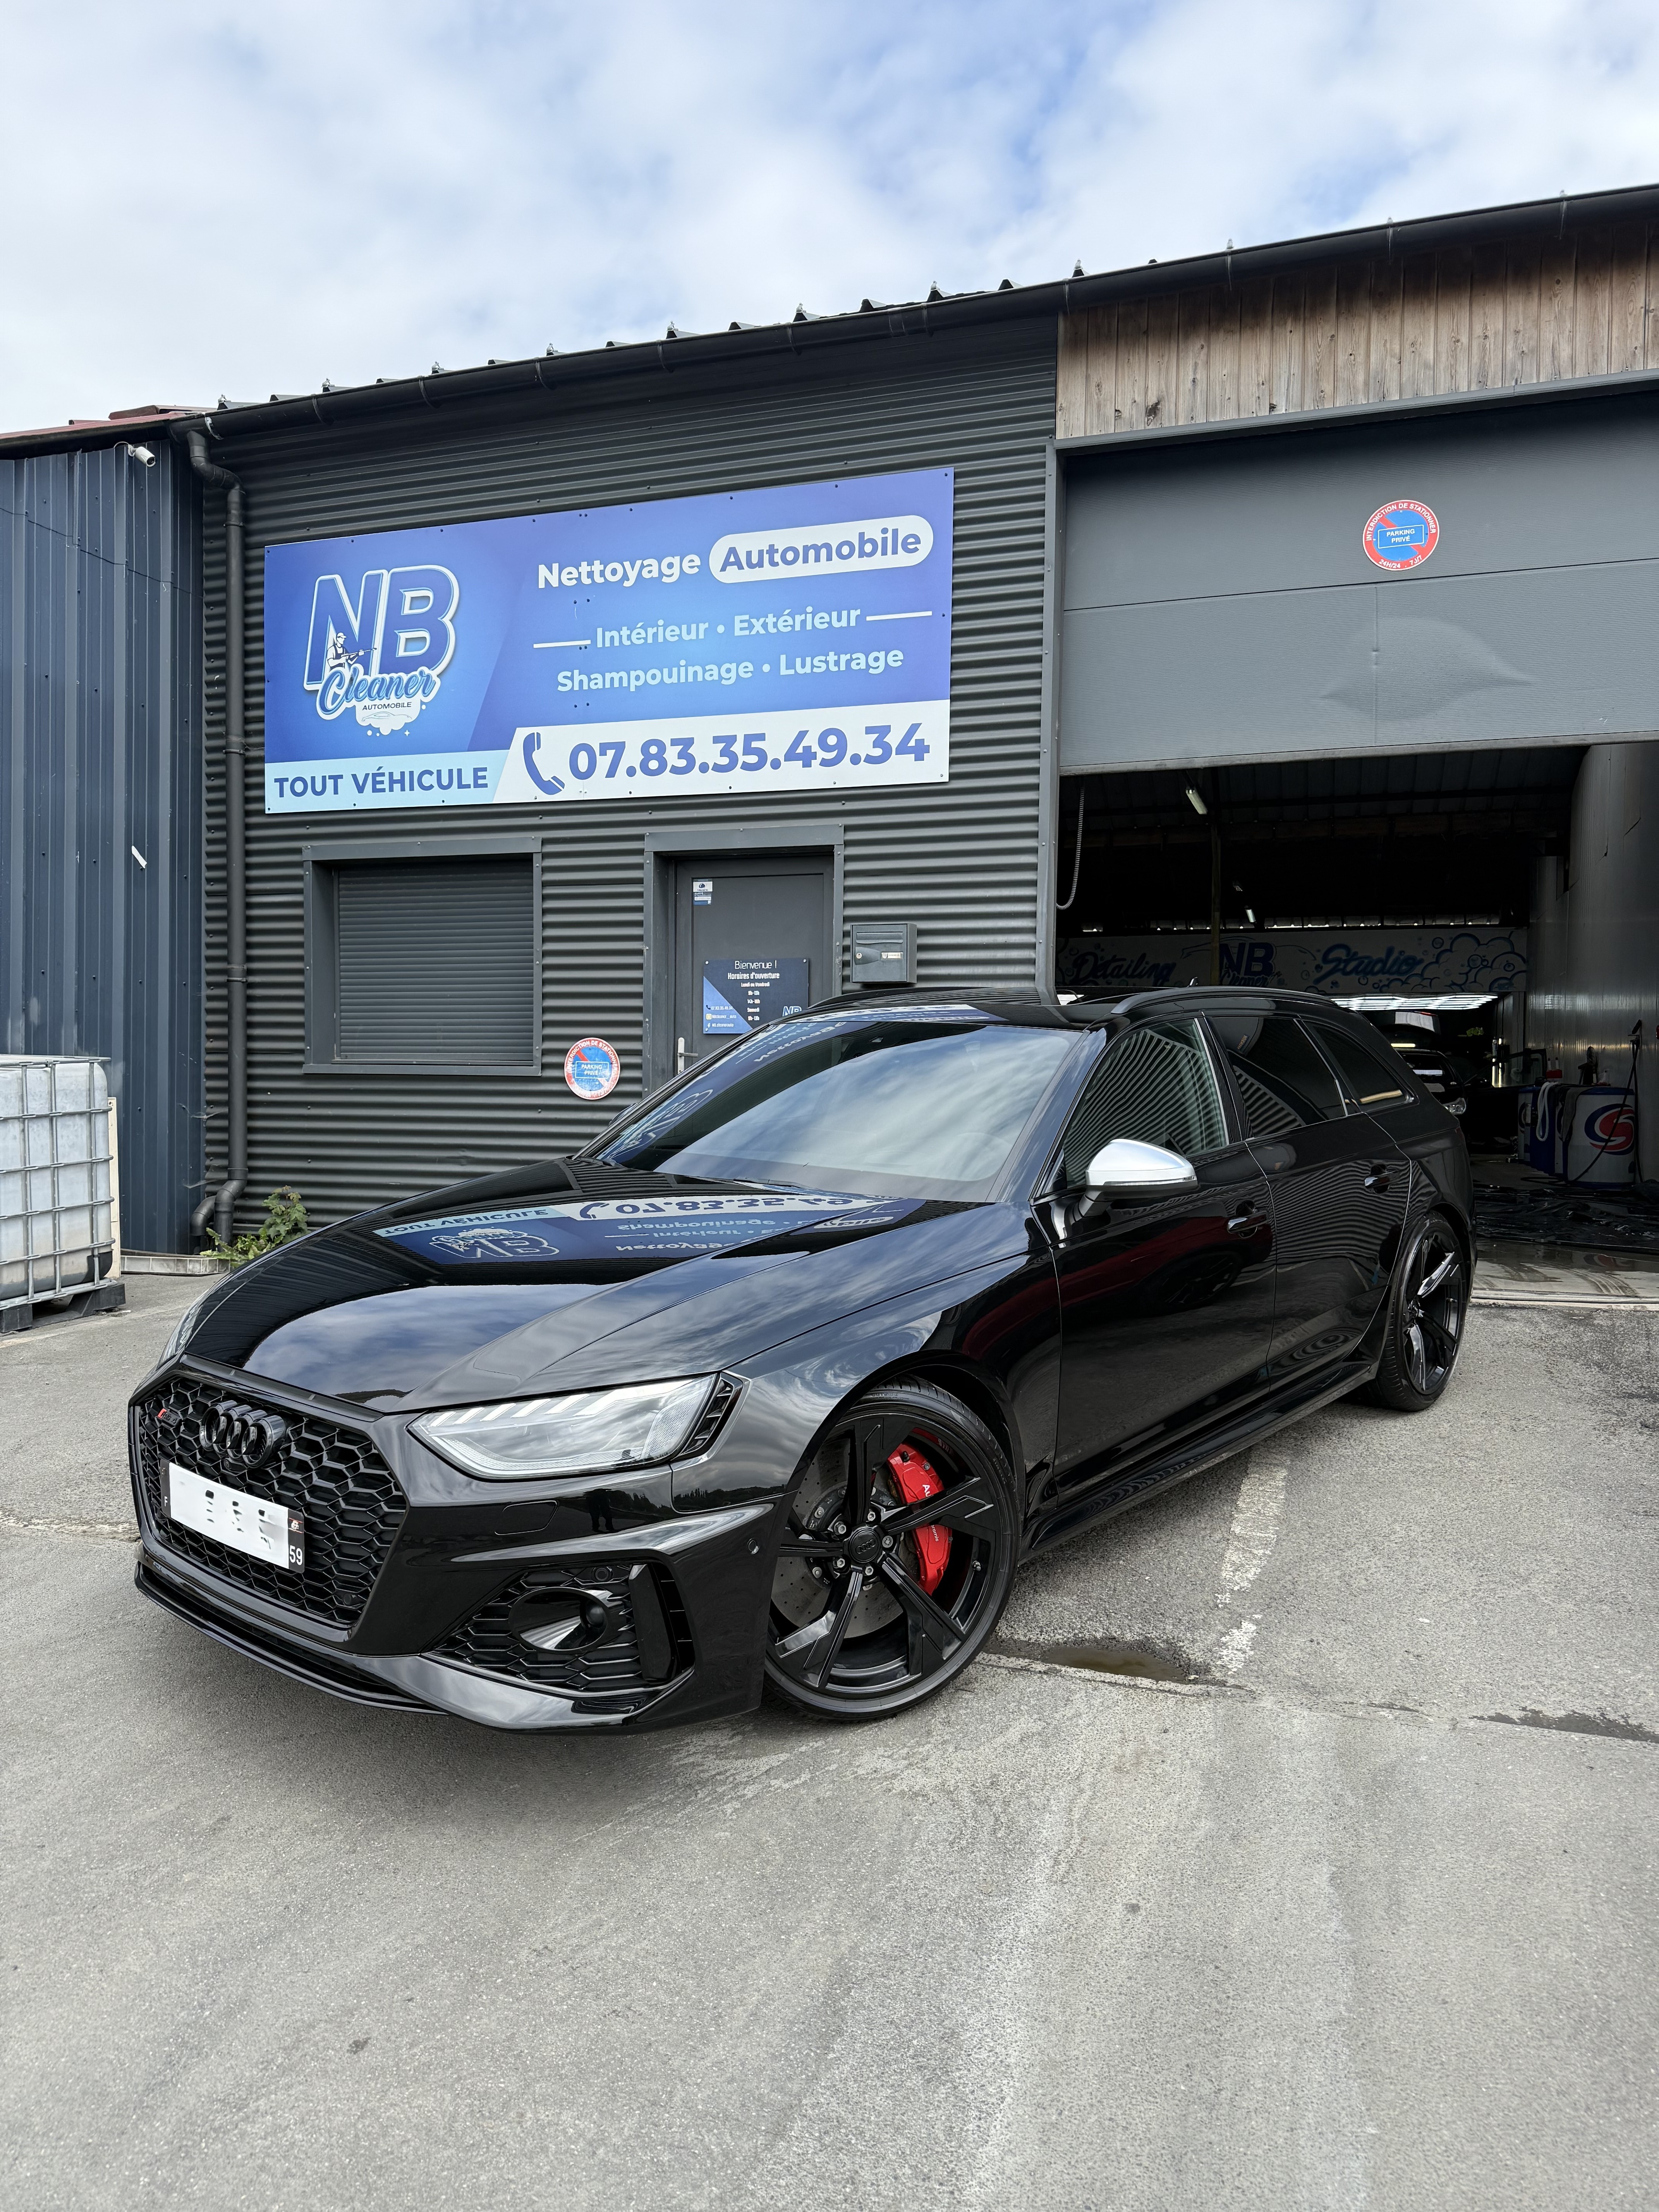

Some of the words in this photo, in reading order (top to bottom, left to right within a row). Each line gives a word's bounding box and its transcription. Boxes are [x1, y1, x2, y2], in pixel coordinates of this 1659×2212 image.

[1366, 504, 1397, 541] INTERDICTION
[1409, 503, 1436, 534] STATIONNER
[1386, 529, 1415, 537] PARKING
[538, 553, 700, 589] Nettoyage
[720, 528, 921, 573] Automobile
[1379, 559, 1401, 568] 24H/24
[304, 565, 460, 690] NB
[596, 620, 708, 648] Intérieur
[734, 606, 860, 636] Extérieur
[557, 659, 754, 692] Shampouinage
[780, 648, 904, 676] Lustrage
[318, 665, 438, 717] Cleaner
[362, 702, 412, 711] AUTOMOBILE
[569, 722, 929, 780] 07.83.35.49.34
[274, 775, 343, 797] TOUT
[351, 766, 488, 794] VÉHICULE
[735, 961, 772, 969] Bienvenue
[1070, 951, 1176, 987] Detailing
[1219, 942, 1275, 976] NB
[1313, 943, 1424, 985] Studio
[164, 1496, 168, 1507] F
[922, 1484, 931, 1497] Au
[289, 1545, 303, 1565] 59
